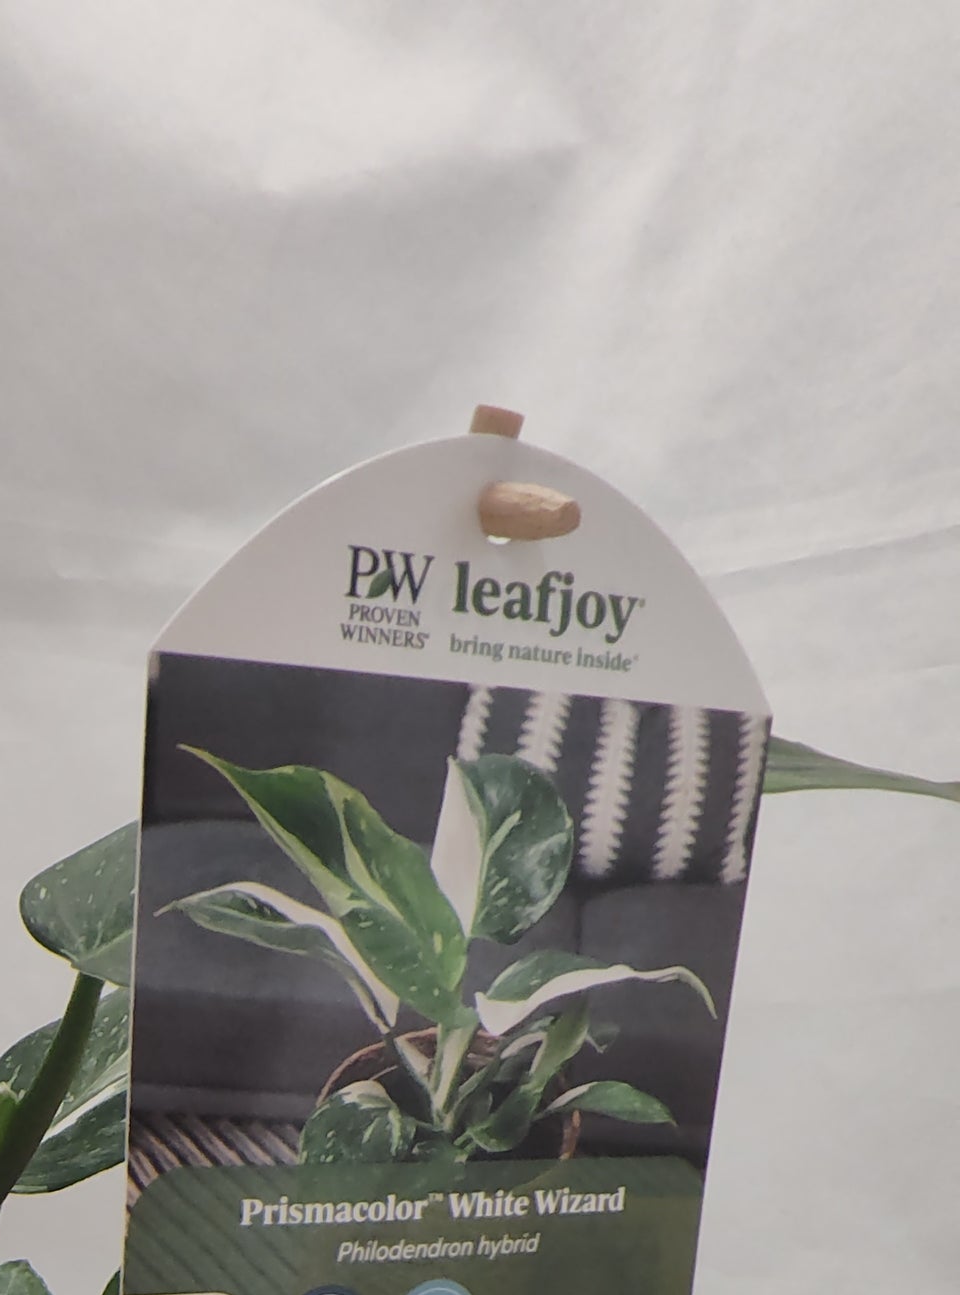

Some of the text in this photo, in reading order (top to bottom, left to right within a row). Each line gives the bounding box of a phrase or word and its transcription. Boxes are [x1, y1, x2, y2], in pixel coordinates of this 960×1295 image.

[345, 545, 435, 605] PW
[348, 603, 421, 627] PROVEN
[450, 634, 504, 661] bring
[508, 642, 573, 665] nature
[449, 1190, 529, 1219] White
[534, 1187, 626, 1215] Wizard
[338, 1233, 539, 1262] Philodendron hybrid
